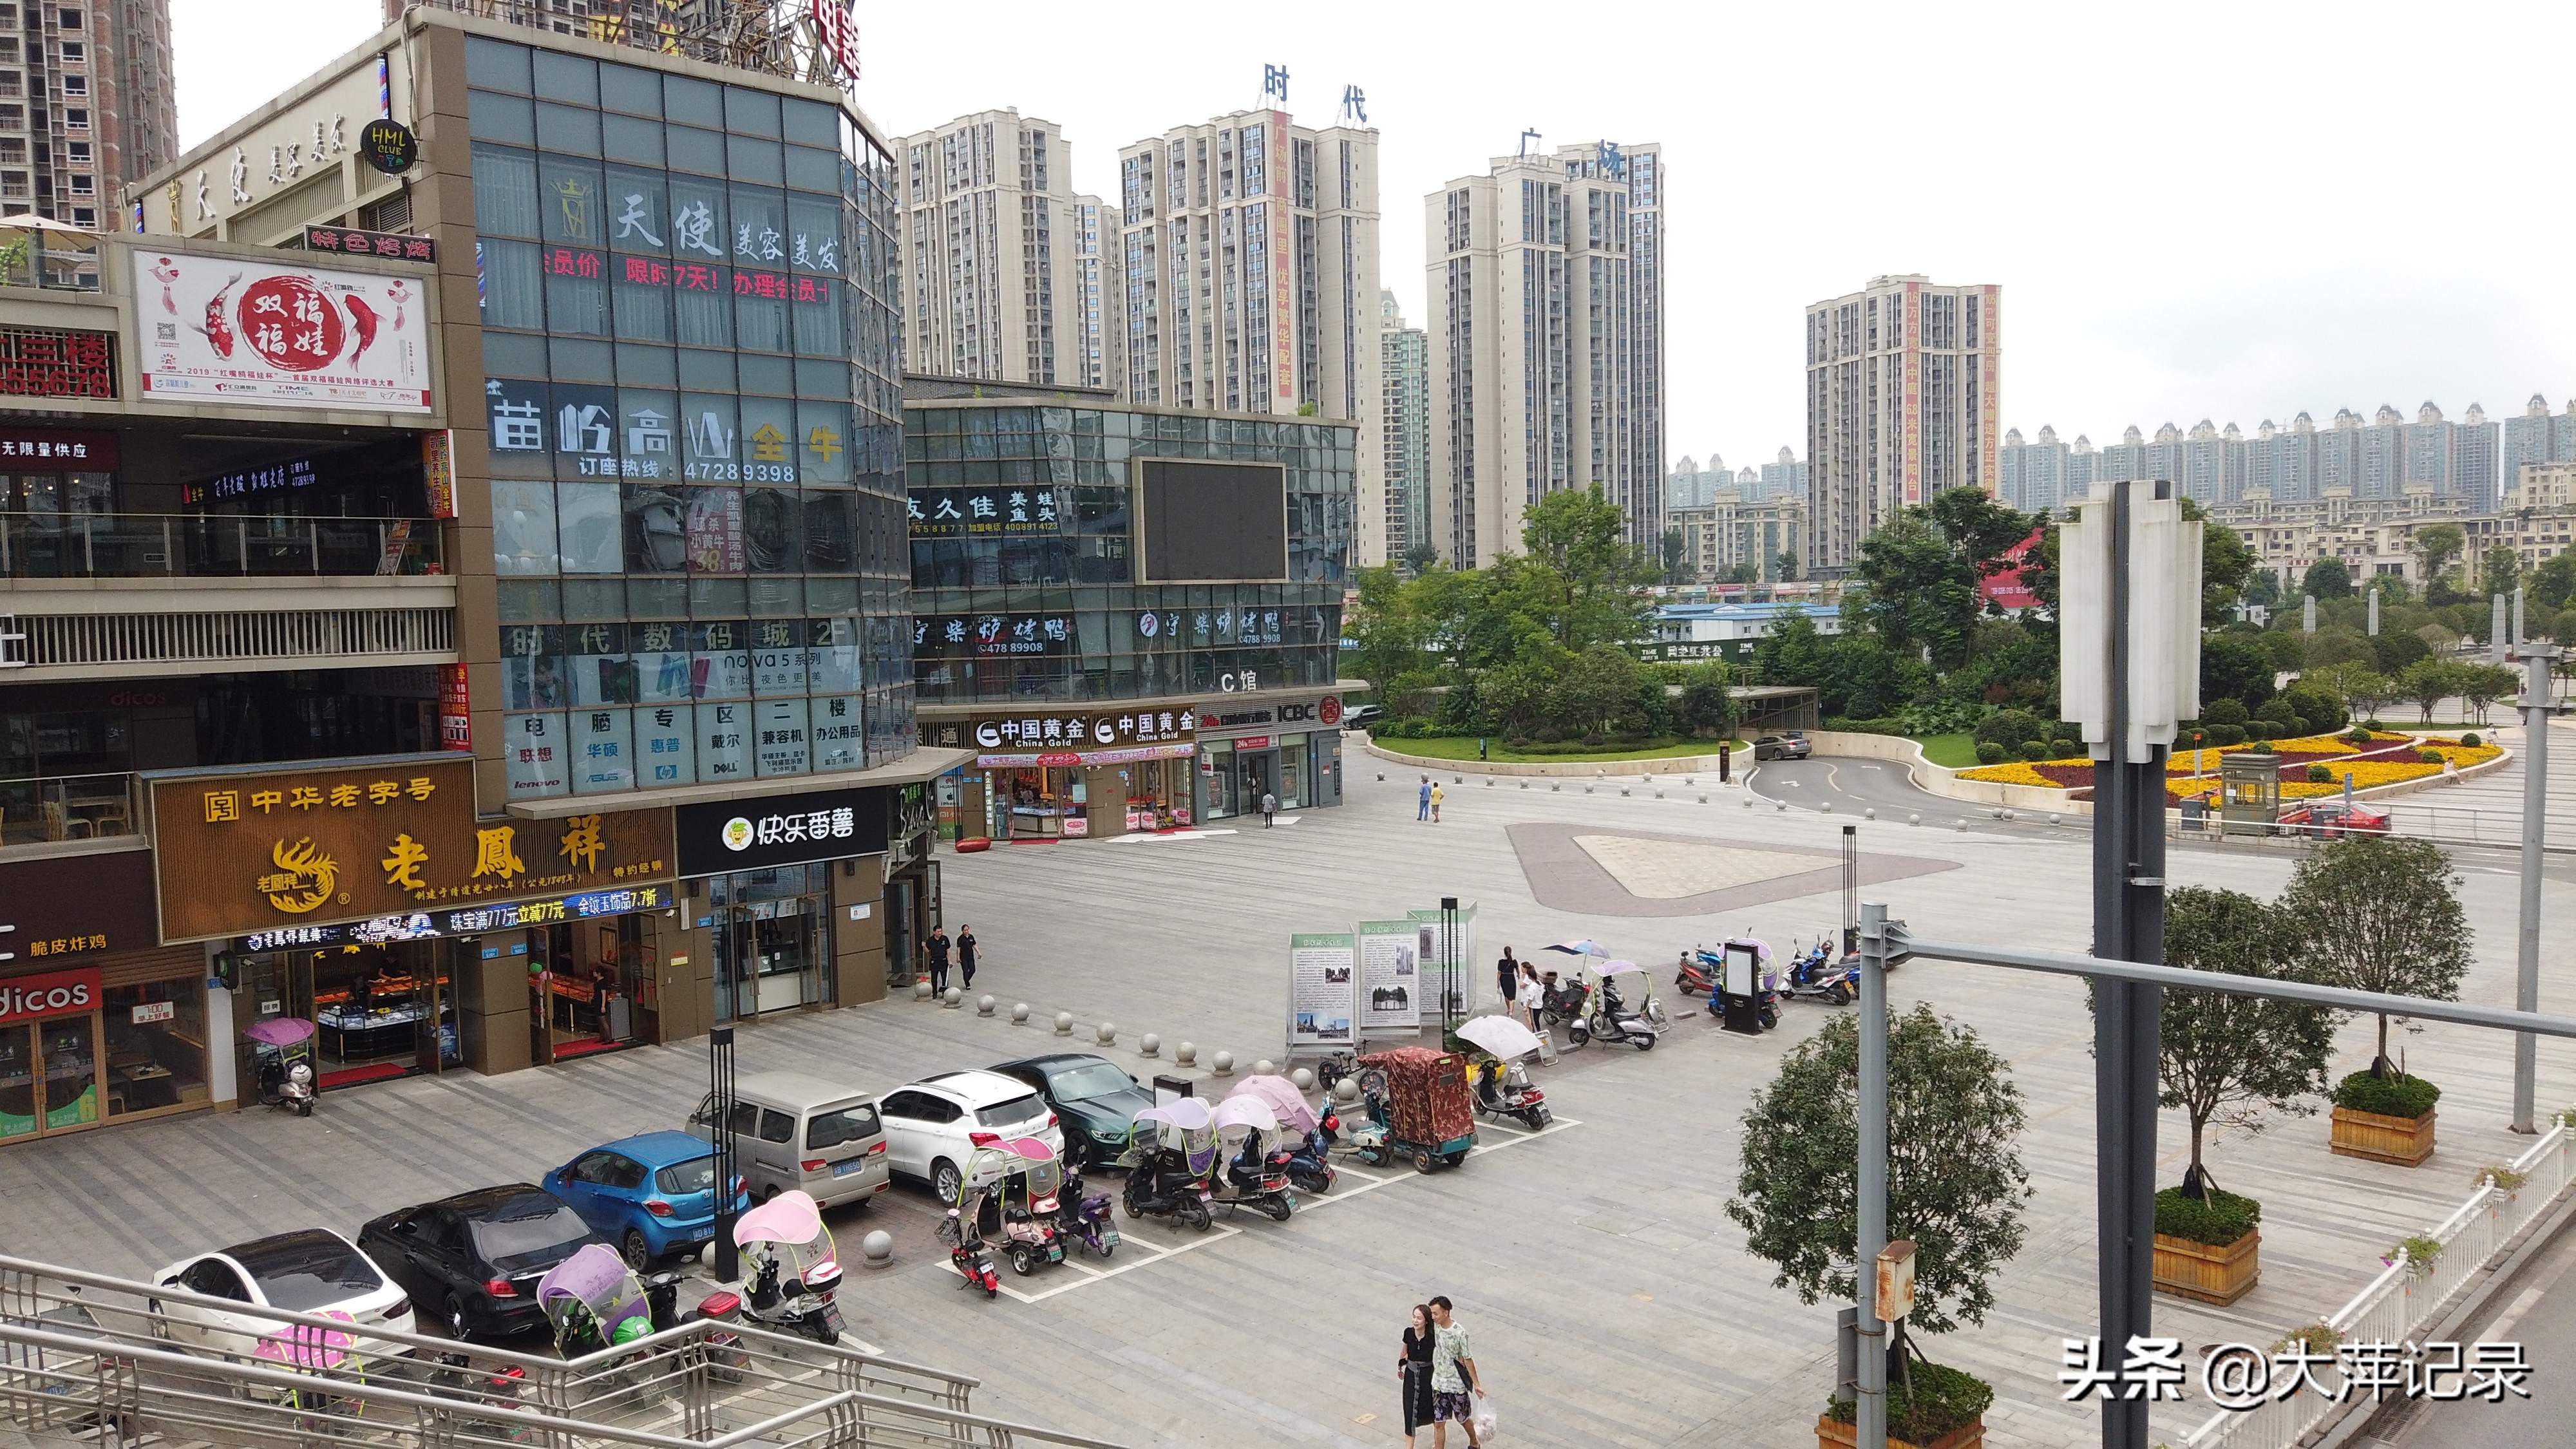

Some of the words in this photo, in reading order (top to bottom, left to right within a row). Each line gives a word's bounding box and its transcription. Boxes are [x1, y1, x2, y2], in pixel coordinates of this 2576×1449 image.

[372, 127, 406, 147] HML
[377, 145, 402, 156] CLUB
[616, 194, 723, 256] 天使
[733, 225, 785, 262] 美容
[790, 234, 839, 274] 美发
[253, 292, 325, 323] 双福
[255, 323, 328, 356] 福娃
[2, 441, 88, 458] 无限量供应
[724, 654, 776, 668] nova
[782, 653, 790, 667] 5
[794, 652, 821, 666] 系列
[1278, 704, 1316, 723] ICBC
[1001, 718, 1085, 741] 中国黄金
[1118, 710, 1194, 735] 中国黄金
[762, 728, 804, 746] 兼容机
[815, 725, 860, 741] 办公用品
[1136, 733, 1158, 742] China
[1160, 731, 1179, 740] Gold
[587, 742, 619, 759] 华硕
[650, 737, 681, 754] 惠普
[711, 734, 740, 750] 戴尔
[1016, 739, 1043, 748] China
[1048, 739, 1072, 747] Gold
[519, 746, 553, 763] 联想
[713, 763, 738, 774] DELL
[514, 779, 560, 789] lenovo
[585, 773, 619, 783] ASUS
[251, 777, 436, 815] 中华老字号
[757, 807, 855, 846] 快乐番薯
[30, 934, 107, 957] 脆皮炸鸡
